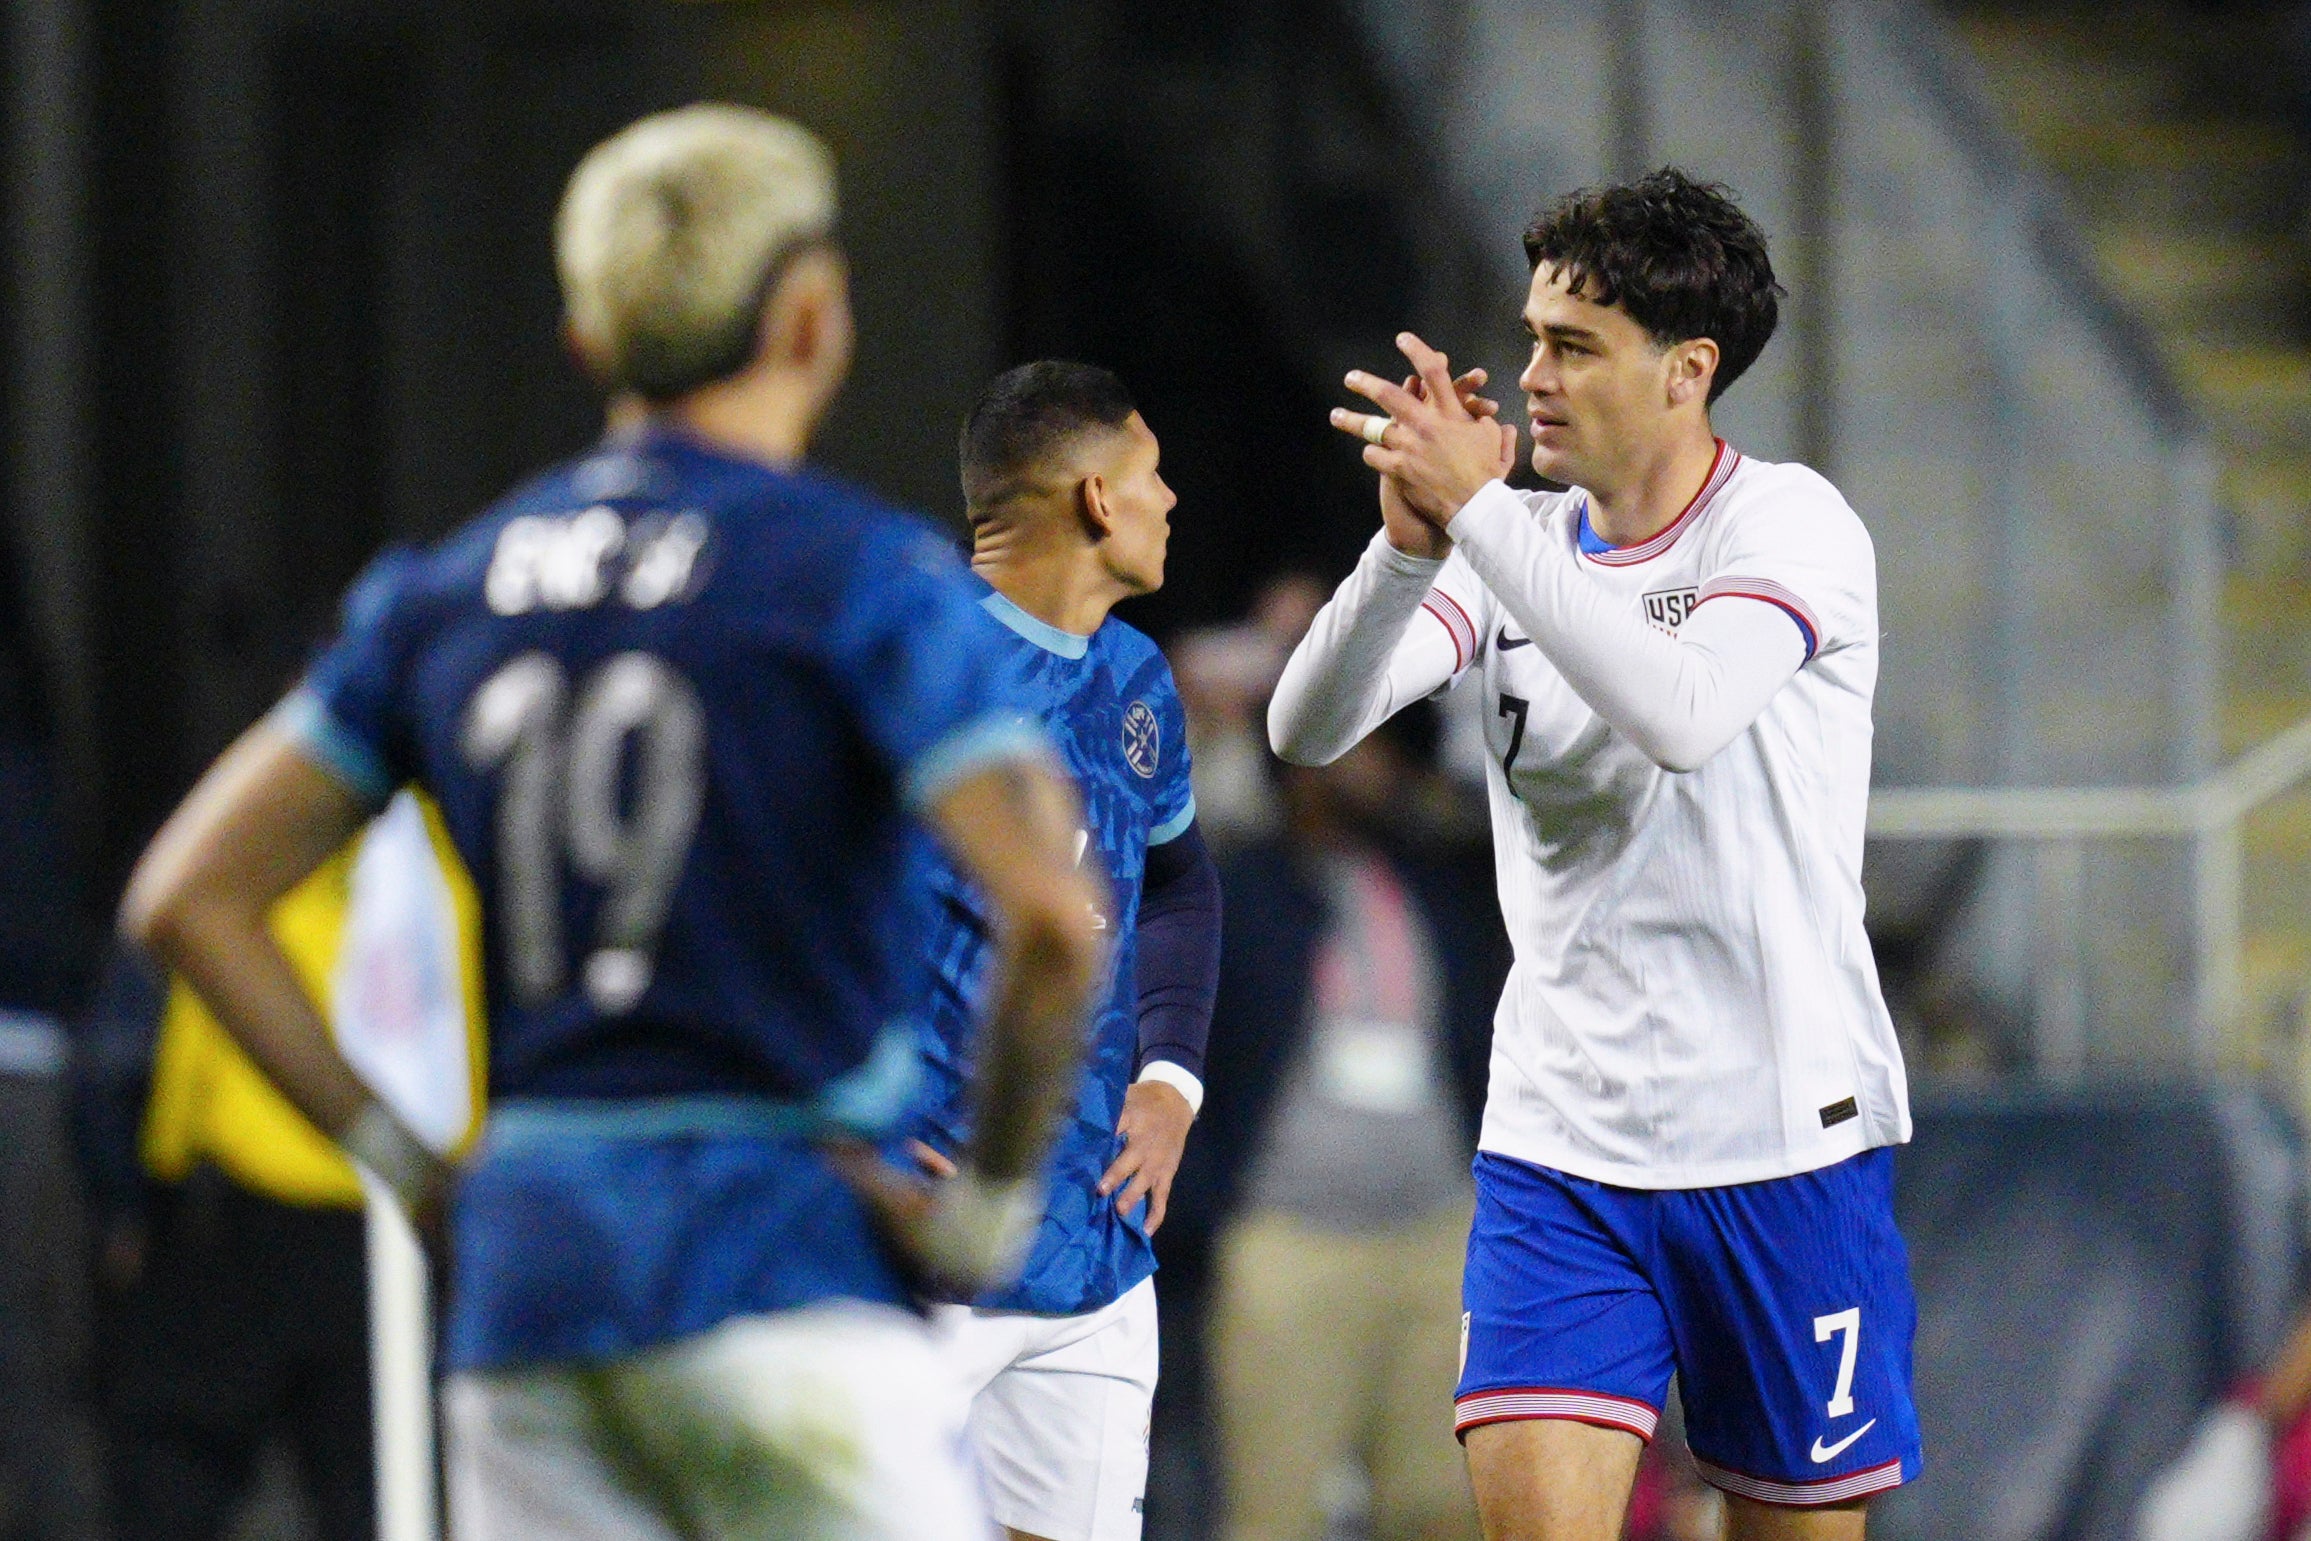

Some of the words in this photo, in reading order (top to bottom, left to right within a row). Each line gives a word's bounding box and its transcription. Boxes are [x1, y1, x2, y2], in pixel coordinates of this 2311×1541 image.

[1499, 692, 1530, 799] 7
[464, 650, 706, 1000] 19
[1814, 1307, 1860, 1418] 7
